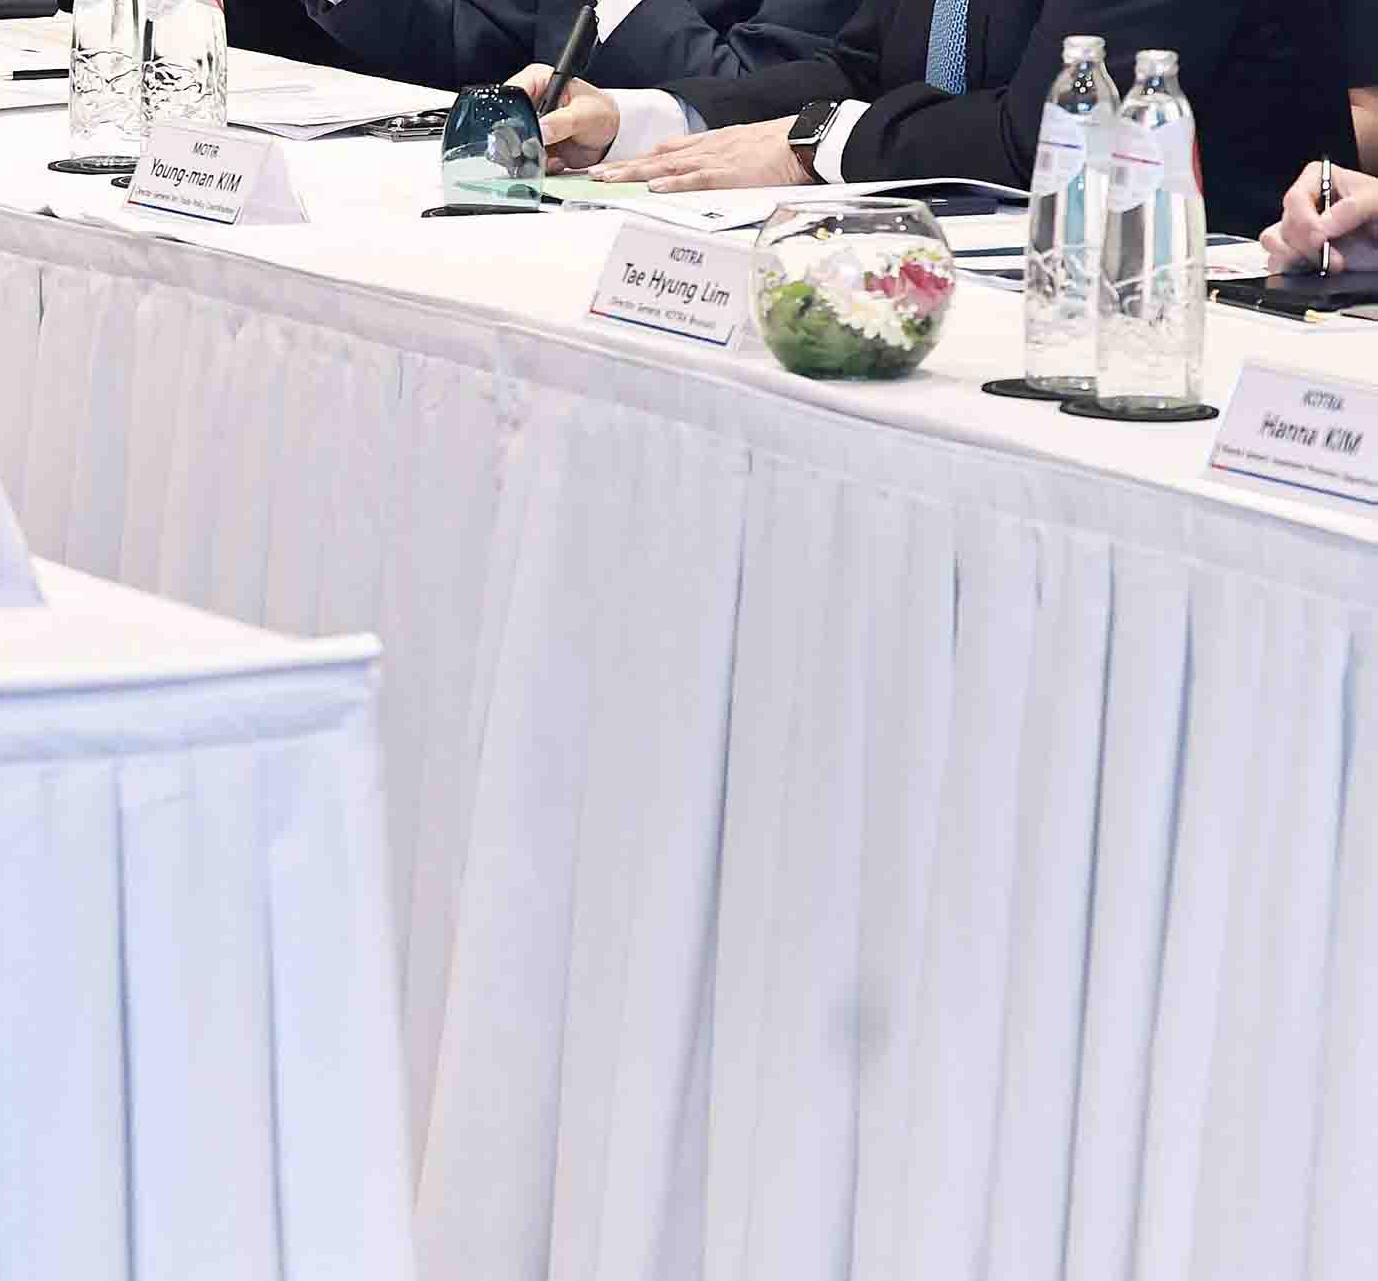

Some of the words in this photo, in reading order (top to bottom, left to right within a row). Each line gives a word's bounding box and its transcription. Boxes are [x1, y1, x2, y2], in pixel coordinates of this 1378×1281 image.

[149, 157, 214, 188] Young-man
[215, 171, 243, 193] KIM
[668, 246, 704, 266] KOTRA
[621, 262, 647, 287] Tae
[648, 269, 698, 304] Hyung
[700, 280, 731, 307] Lim
[1323, 426, 1365, 456] KIM
